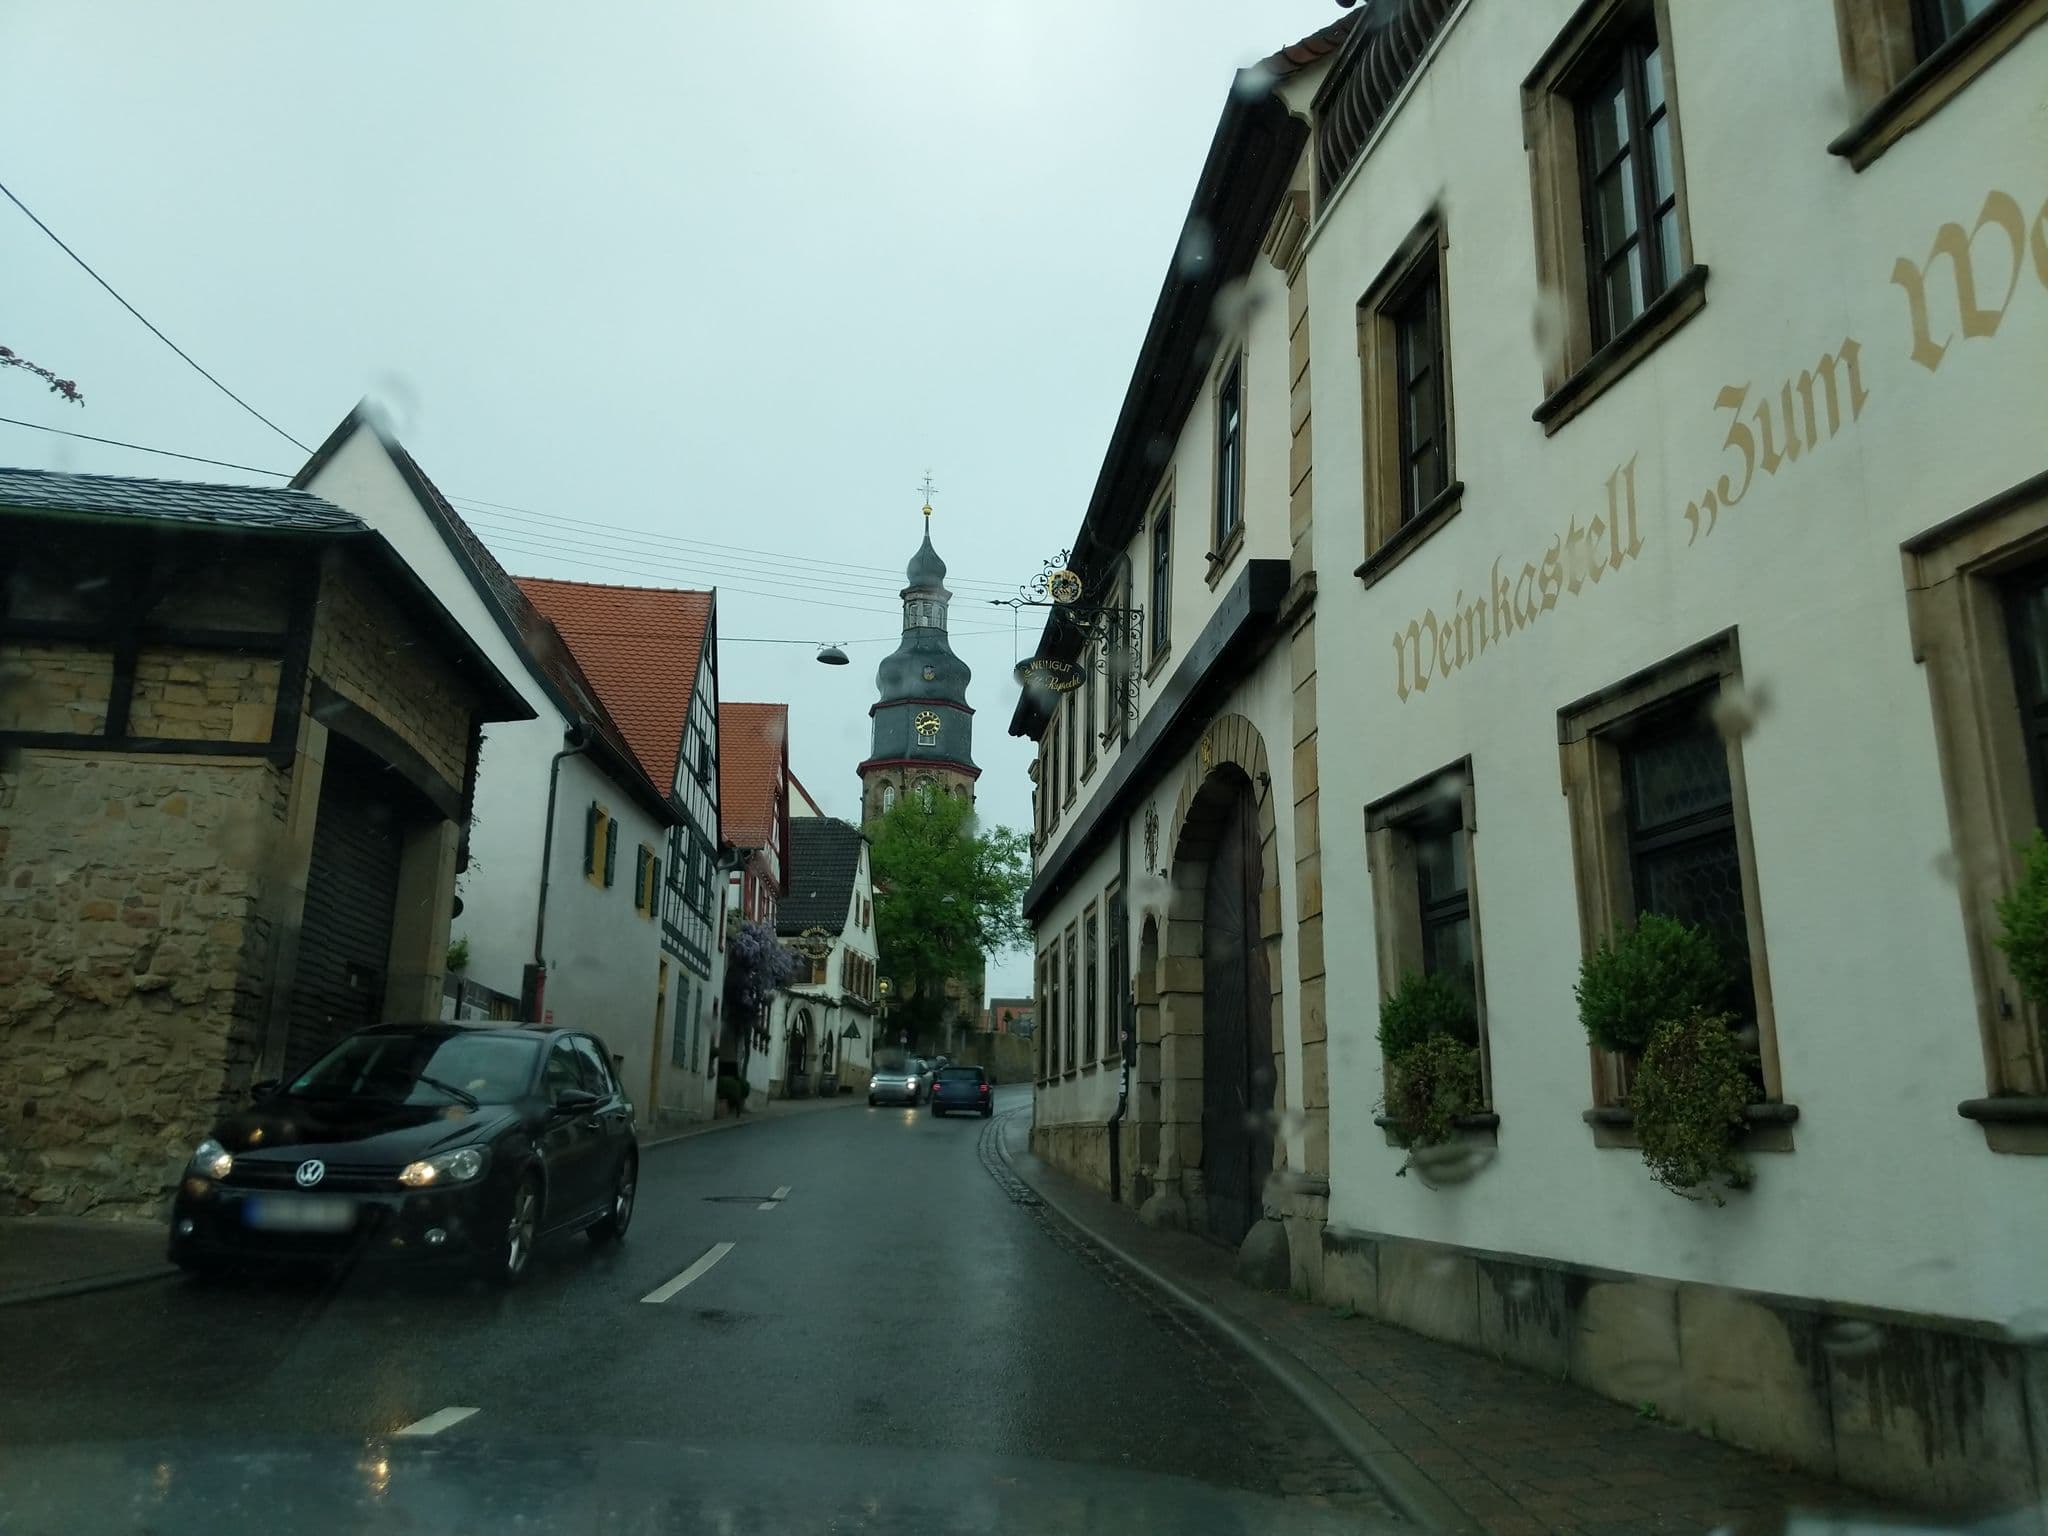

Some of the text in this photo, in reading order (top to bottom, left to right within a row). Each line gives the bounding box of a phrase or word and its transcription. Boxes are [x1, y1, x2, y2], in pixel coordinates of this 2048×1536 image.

[1392, 450, 1646, 705] Weinkastell
[1890, 188, 2048, 374] W
[1030, 660, 1072, 673] WEINGUT
